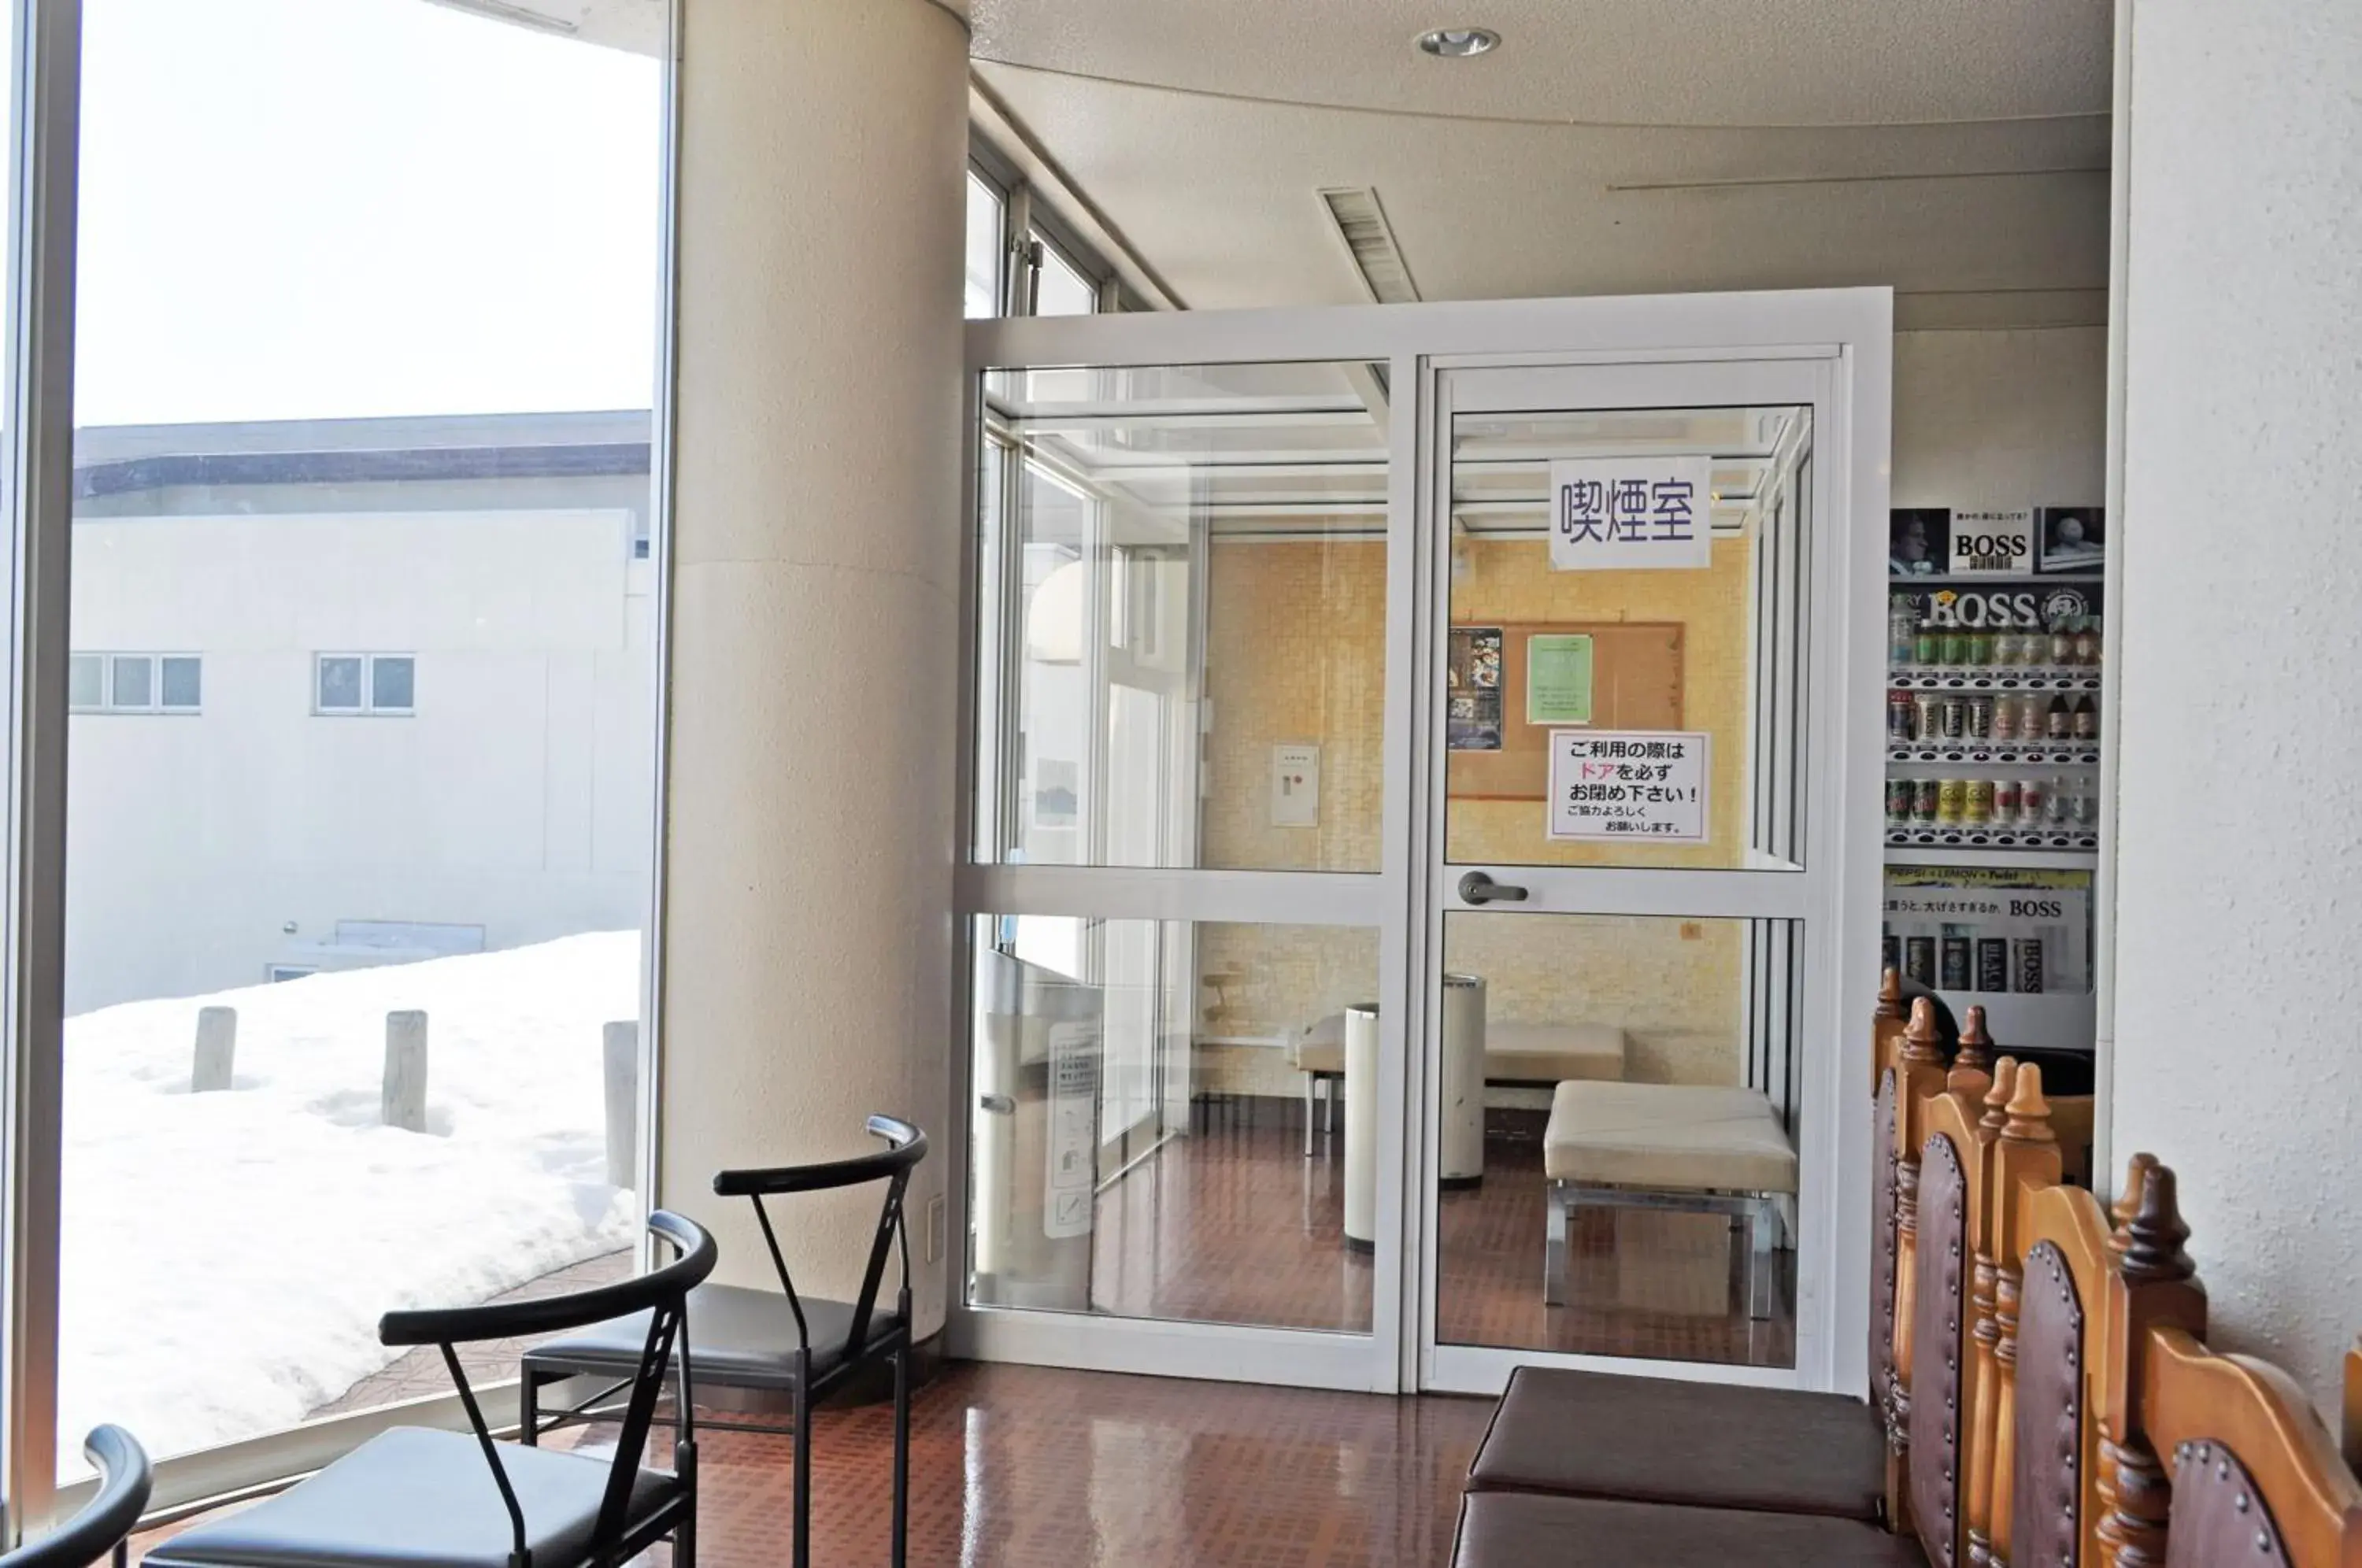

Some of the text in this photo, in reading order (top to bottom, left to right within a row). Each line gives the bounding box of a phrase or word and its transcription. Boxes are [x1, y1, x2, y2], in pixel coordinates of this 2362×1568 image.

[1561, 477, 1694, 544] 喫煙室
[1956, 534, 2027, 557] BOSS
[1925, 592, 2040, 628] BOSS
[1570, 741, 1686, 759] ご利用の際は
[1581, 762, 1673, 780] ドアを必ず
[1567, 805, 1646, 817] ご協力よろしく
[1605, 821, 1680, 834] お願いします。
[2010, 900, 2061, 918] BOSS
